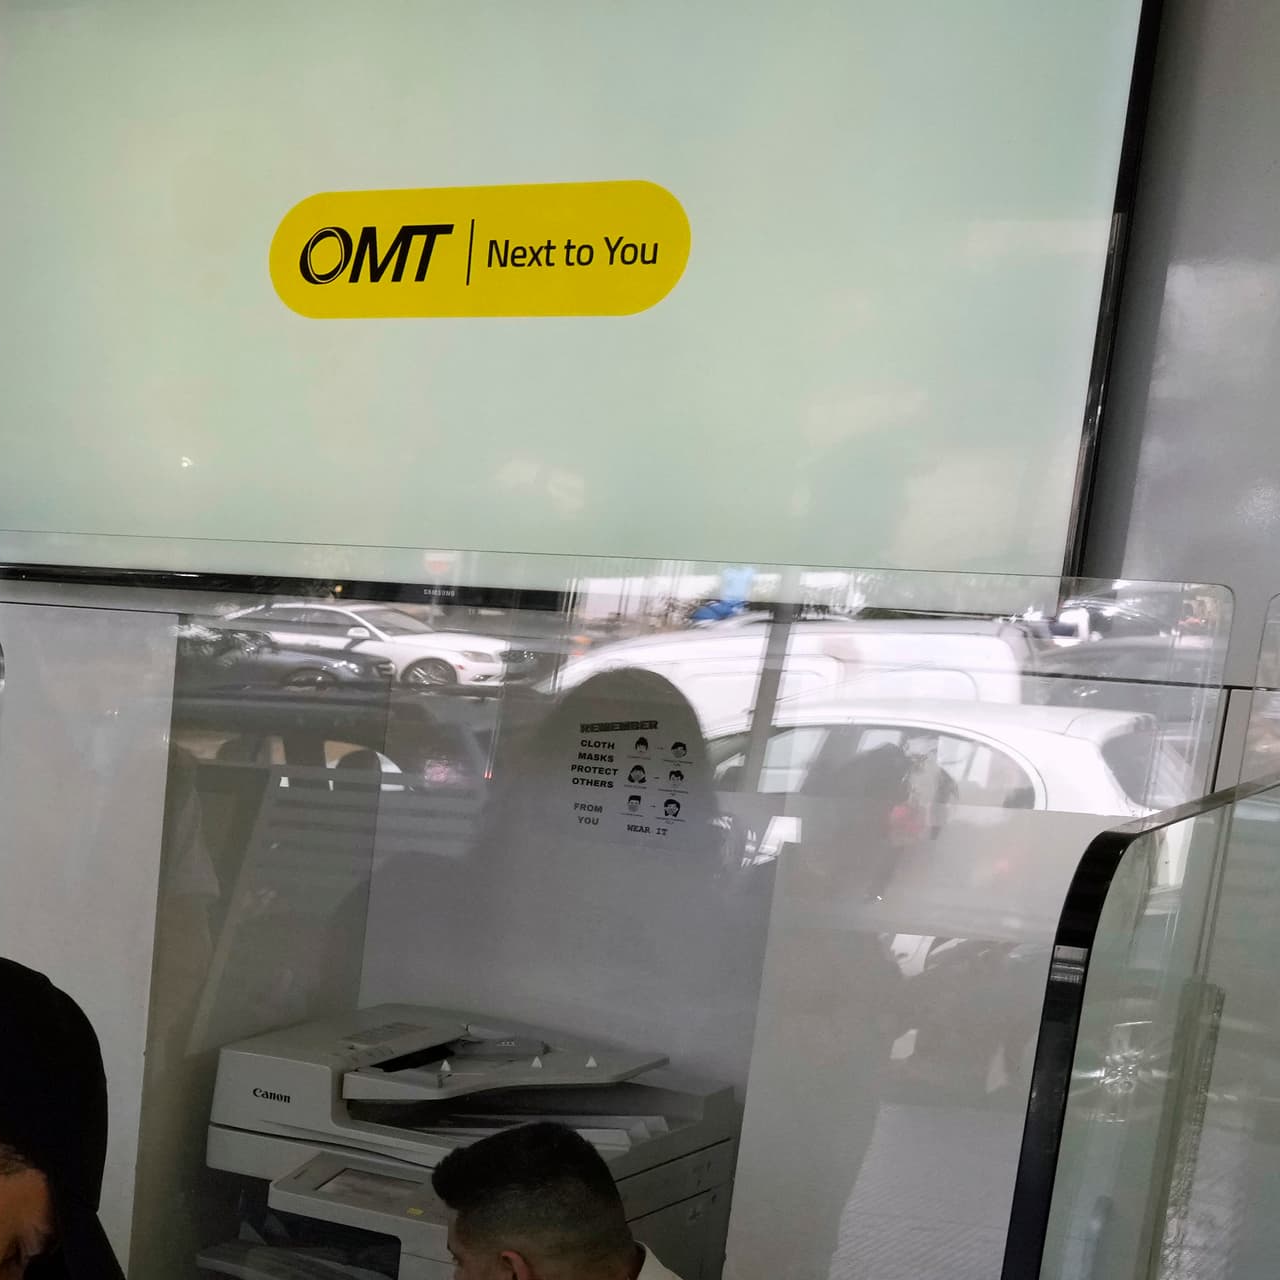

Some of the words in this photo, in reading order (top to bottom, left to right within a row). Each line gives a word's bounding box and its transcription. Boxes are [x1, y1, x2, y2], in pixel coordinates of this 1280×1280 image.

[299, 224, 454, 285] OMT
[487, 238, 556, 268] Next
[564, 240, 594, 267] to
[603, 236, 659, 266] You
[580, 720, 659, 734] REMEMBER
[580, 739, 616, 750] CLOTH
[578, 752, 615, 763] MASKS
[570, 764, 619, 777] PROTECT
[572, 777, 614, 789] OTHERS
[574, 802, 603, 814] FROM
[577, 816, 600, 826] YOU
[627, 824, 651, 835] WEAR
[656, 828, 669, 836] IT
[252, 1087, 291, 1104] Canon
